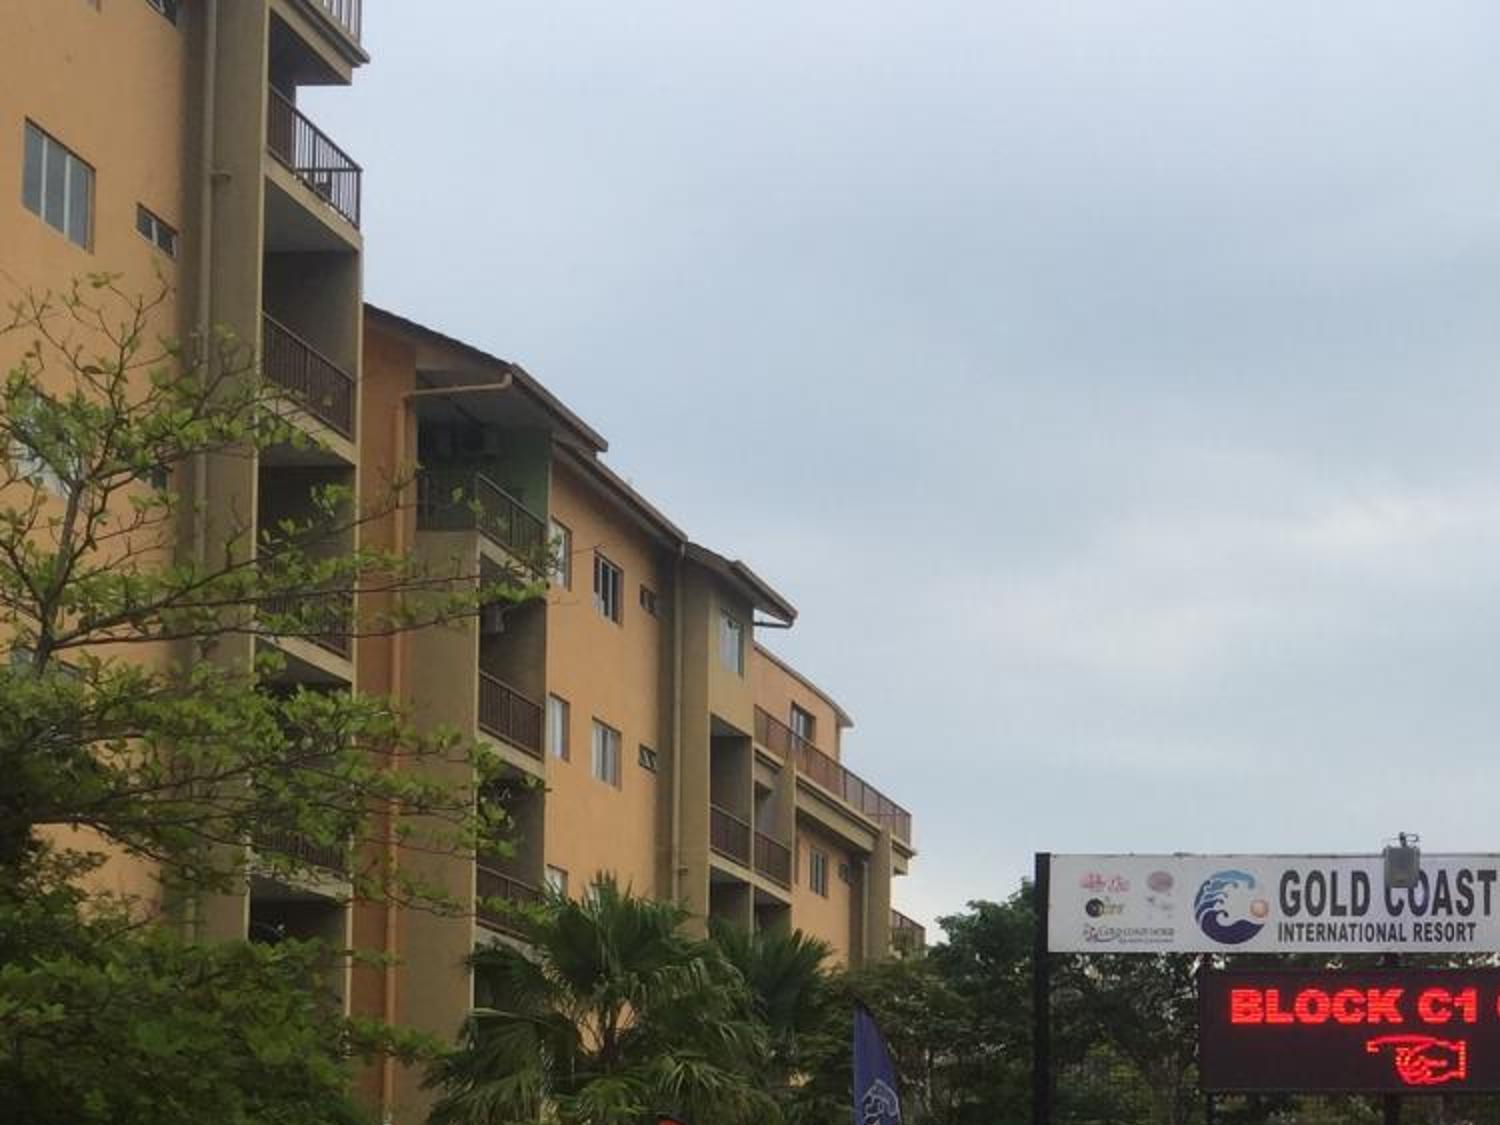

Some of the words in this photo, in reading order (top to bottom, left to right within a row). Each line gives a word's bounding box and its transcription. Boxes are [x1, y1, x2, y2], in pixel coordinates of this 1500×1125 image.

[1279, 869, 1371, 918] GOLD
[1383, 869, 1498, 918] COAST
[1277, 923, 1407, 943] INTERNATIONAL
[1412, 922, 1477, 942] RESORT
[1231, 988, 1404, 1024] BLOCK
[1417, 988, 1478, 1024] C1
